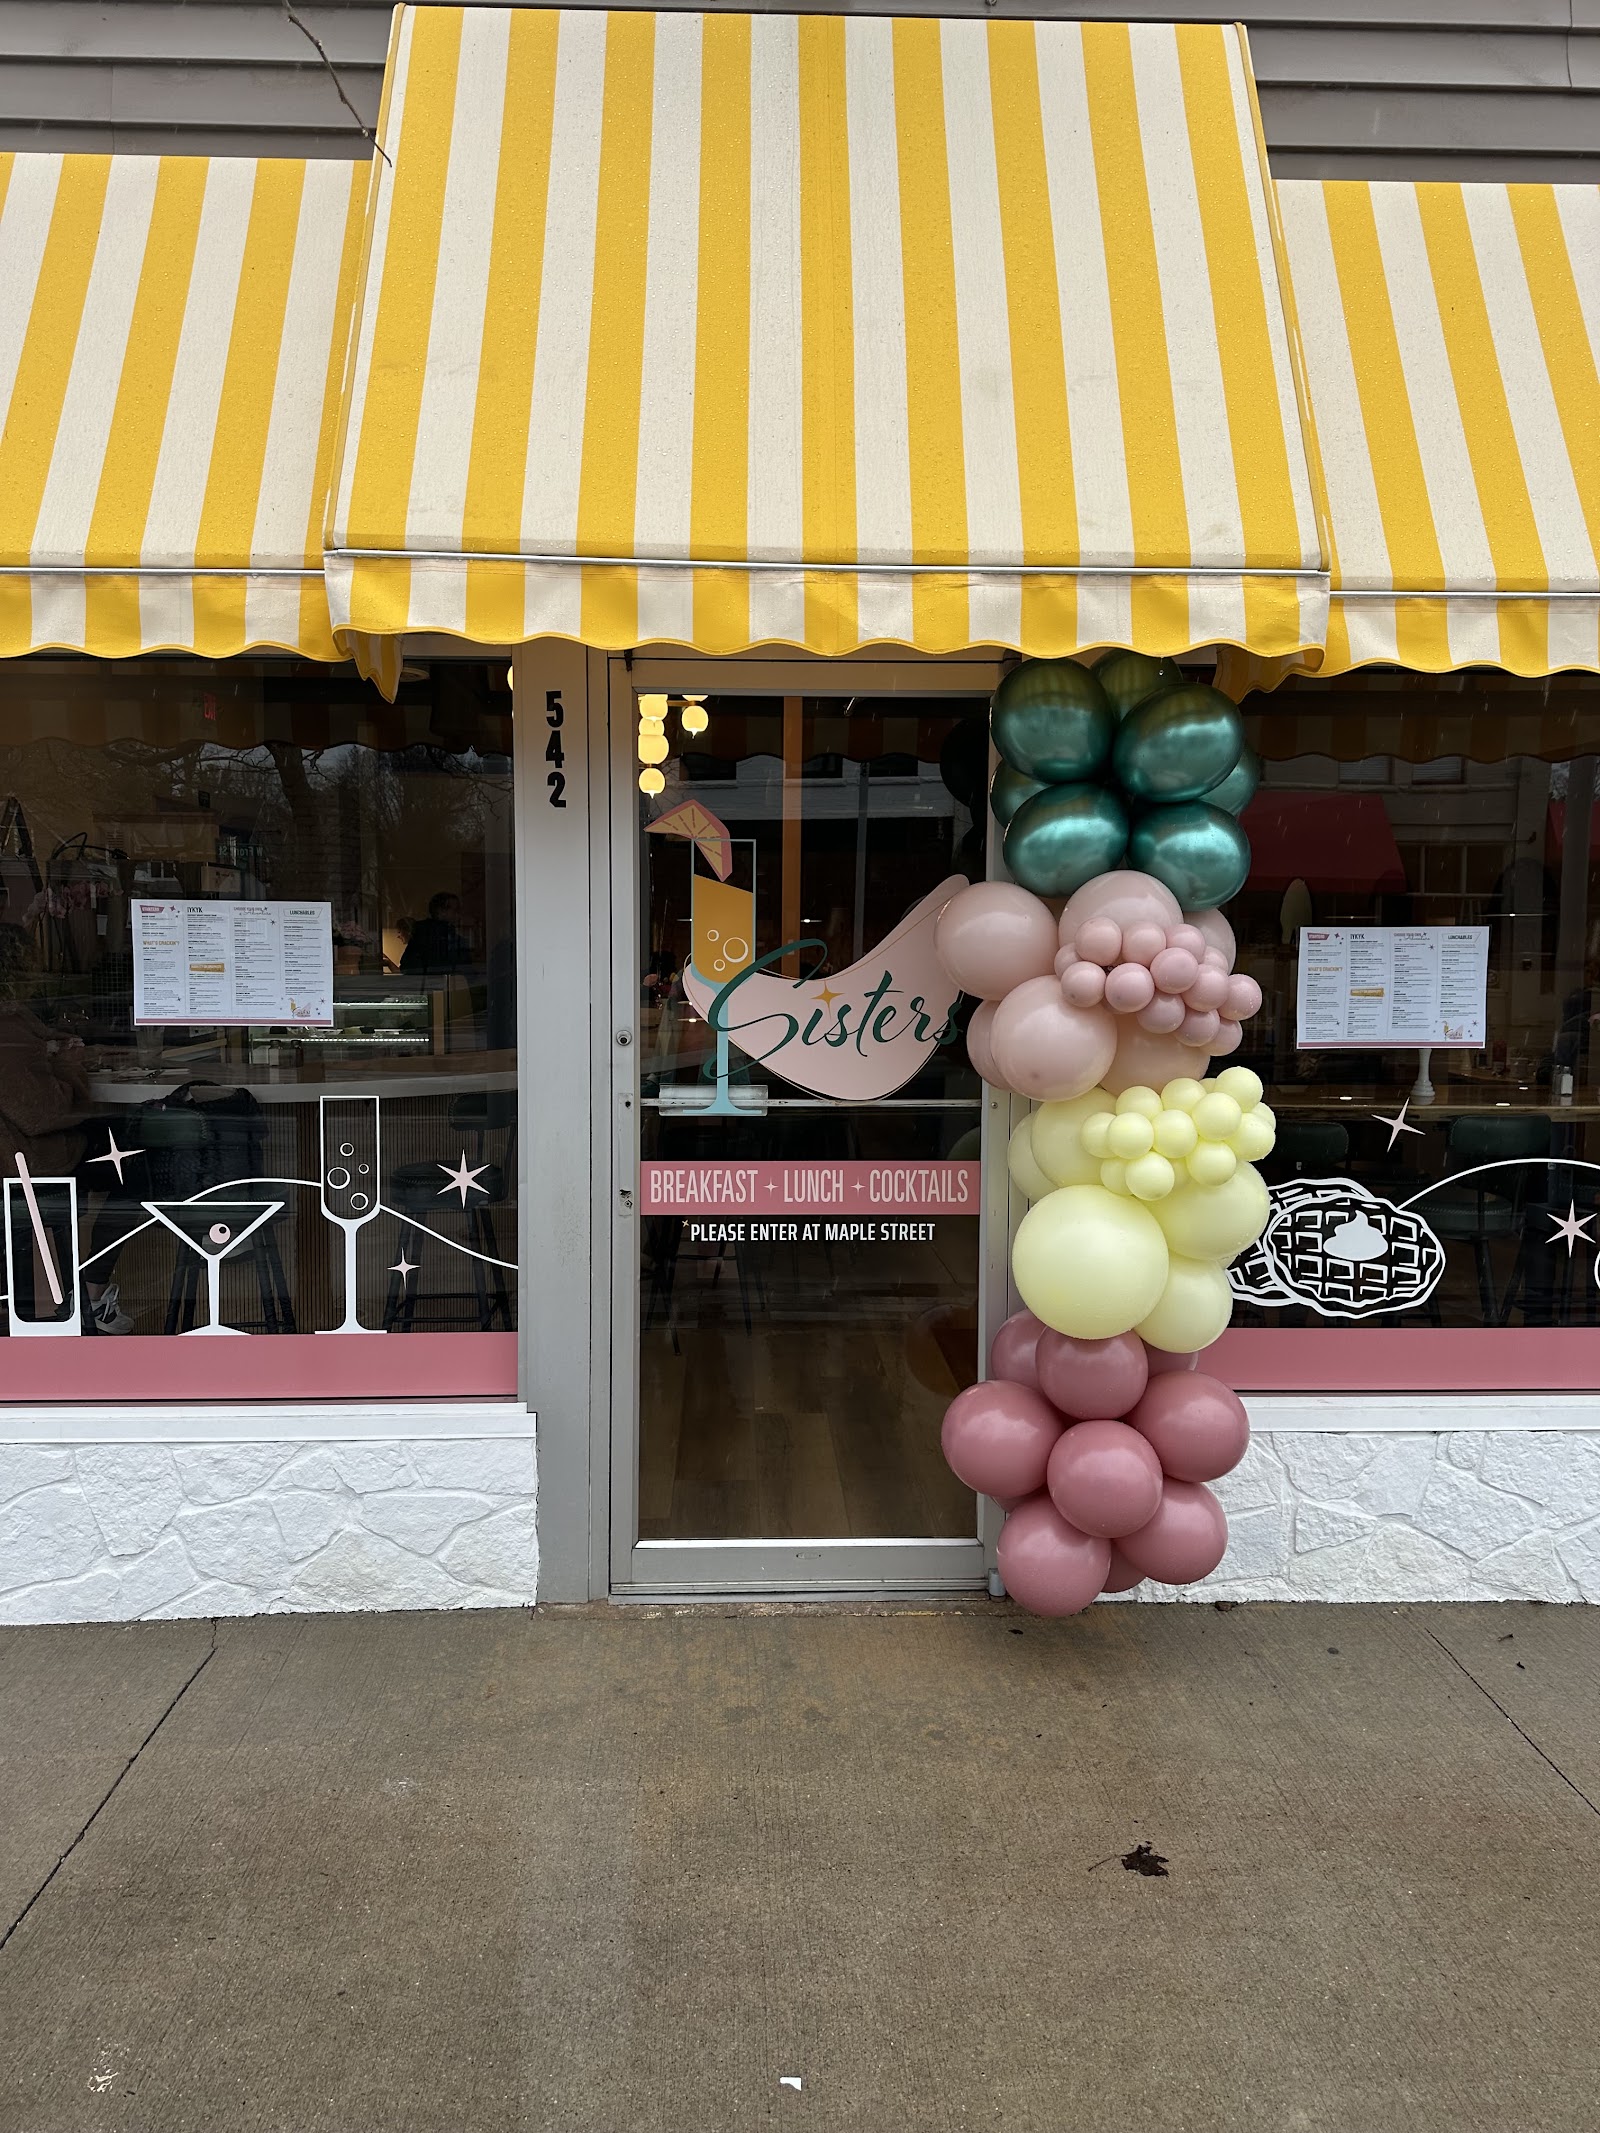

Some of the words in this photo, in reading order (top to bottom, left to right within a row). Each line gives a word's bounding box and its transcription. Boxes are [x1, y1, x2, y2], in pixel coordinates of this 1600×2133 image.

[545, 689, 567, 808] 542
[702, 938, 964, 1079] Sisters
[650, 1169, 759, 1203] BREAKFAST
[783, 1169, 844, 1203] LUNCH
[869, 1169, 969, 1203] COCKTAILS
[690, 1223, 746, 1243] PLEASE
[750, 1223, 798, 1243] ENTER
[802, 1223, 822, 1242] AT
[824, 1223, 876, 1242] MAPLE
[880, 1222, 935, 1242] STREET
